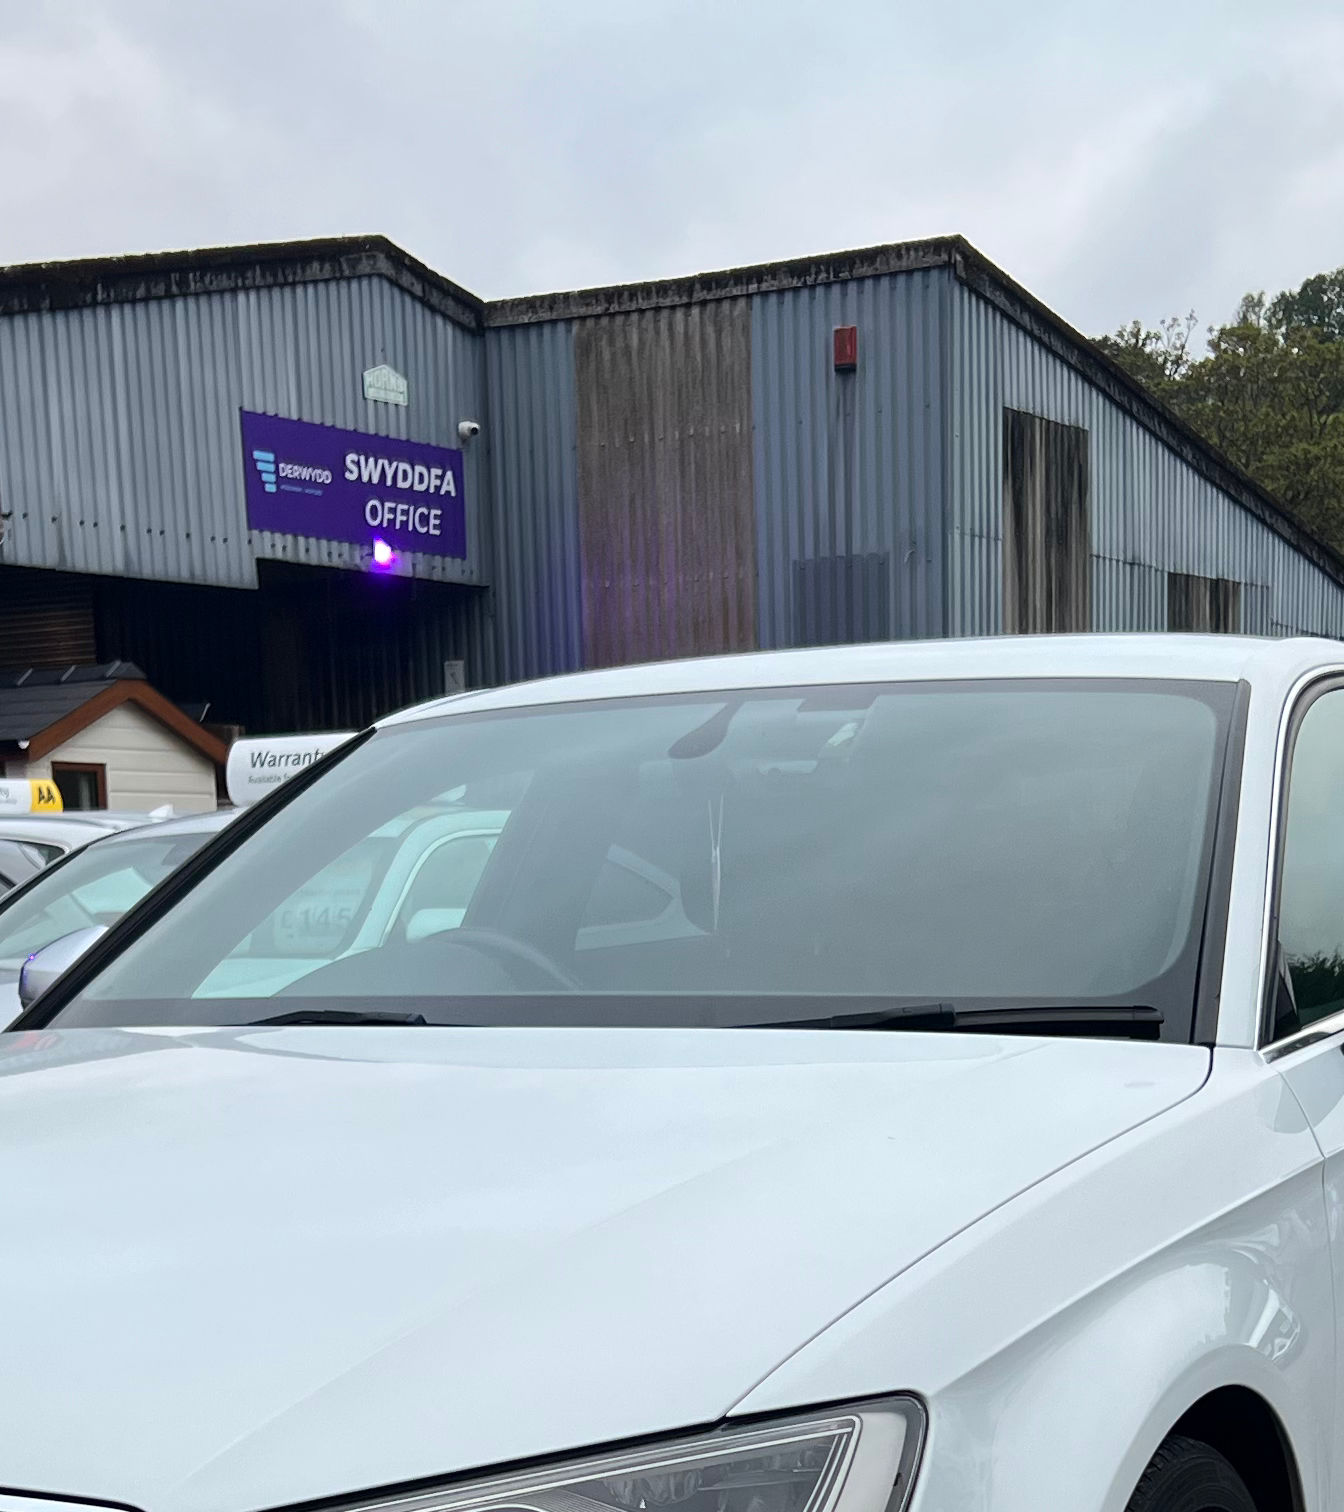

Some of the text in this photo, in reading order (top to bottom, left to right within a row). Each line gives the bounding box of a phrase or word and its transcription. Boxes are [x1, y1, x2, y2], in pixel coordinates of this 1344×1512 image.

[278, 463, 332, 484] DERWYDD
[344, 452, 457, 497] SWYDDFA
[365, 499, 443, 536] OFFICE
[250, 747, 326, 769] Warrant
[37, 785, 56, 805] AA
